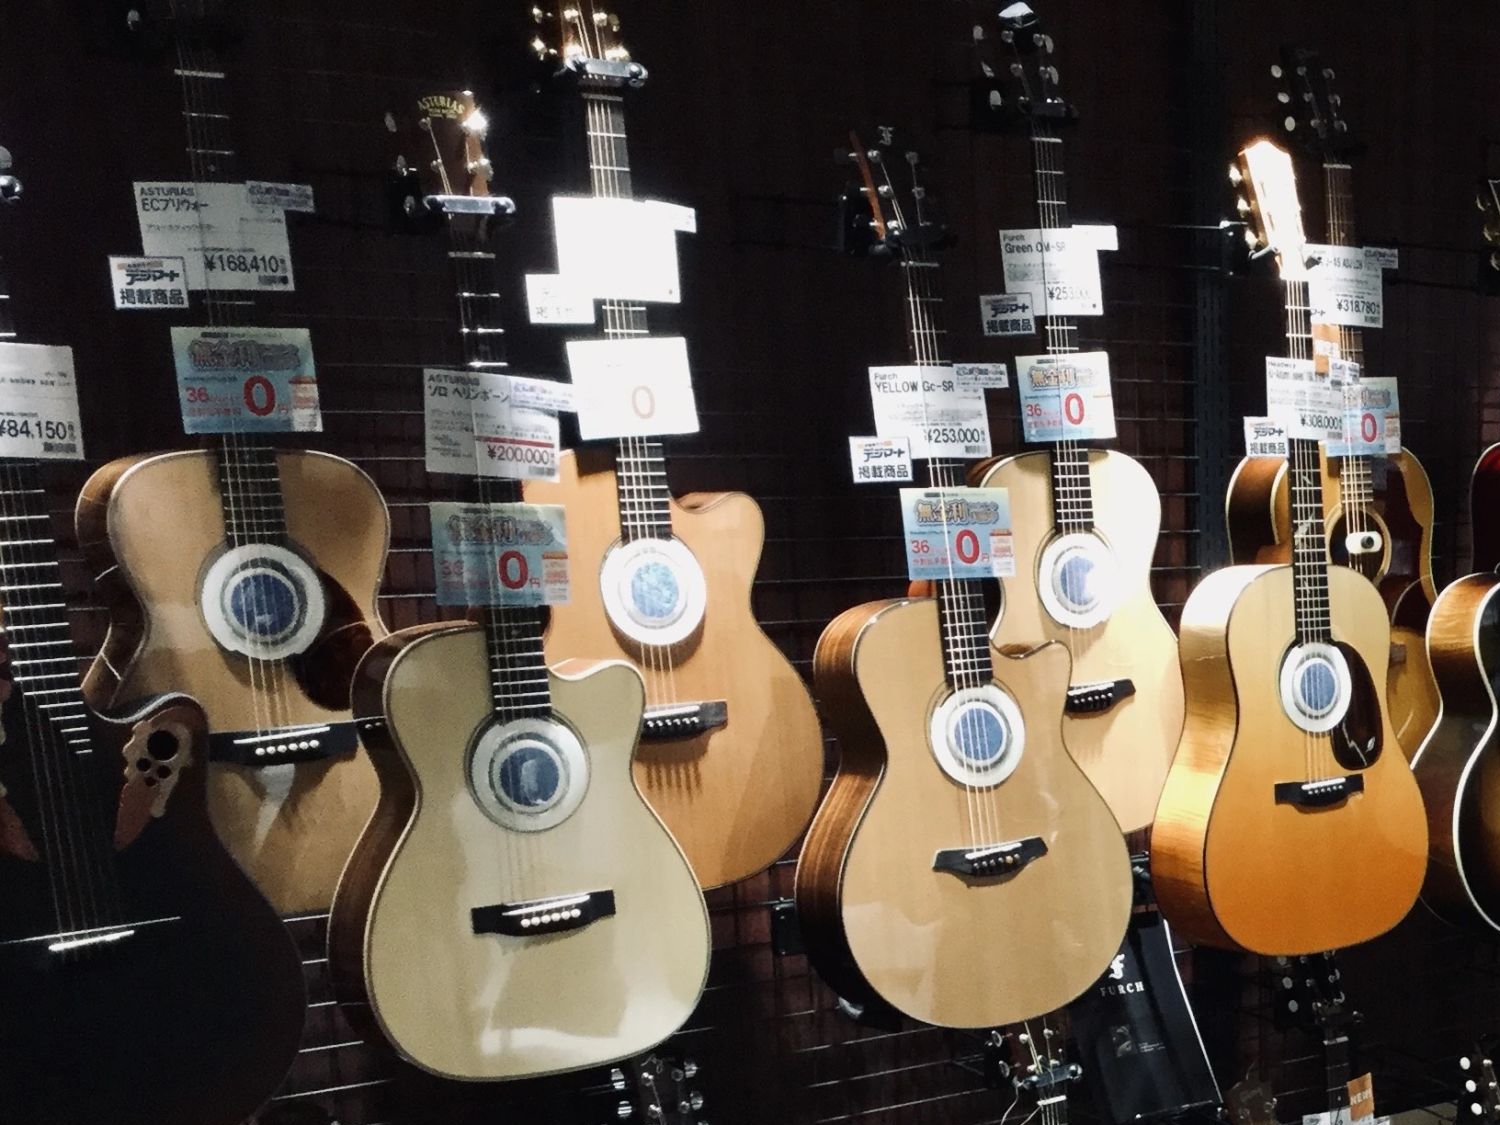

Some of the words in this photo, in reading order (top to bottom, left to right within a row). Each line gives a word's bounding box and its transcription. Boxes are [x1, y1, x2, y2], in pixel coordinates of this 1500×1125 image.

[139, 186, 195, 198] ASTURIAS
[1004, 242, 1033, 253] Green
[427, 373, 480, 387] ASTURIAS
[875, 380, 919, 393] YELLOW
[922, 380, 955, 394] Gc-SR
[243, 375, 276, 417] 0
[1026, 403, 1043, 417] 36
[1063, 392, 1086, 426] 0
[926, 427, 981, 445] ¥253,000
[1360, 412, 1378, 443] 0
[487, 444, 550, 466] ¥200,000
[858, 465, 909, 479] 掲載商品
[910, 540, 930, 554] 36
[955, 529, 980, 564] 0
[499, 550, 529, 590] 0
[1100, 980, 1145, 998] FURCH
